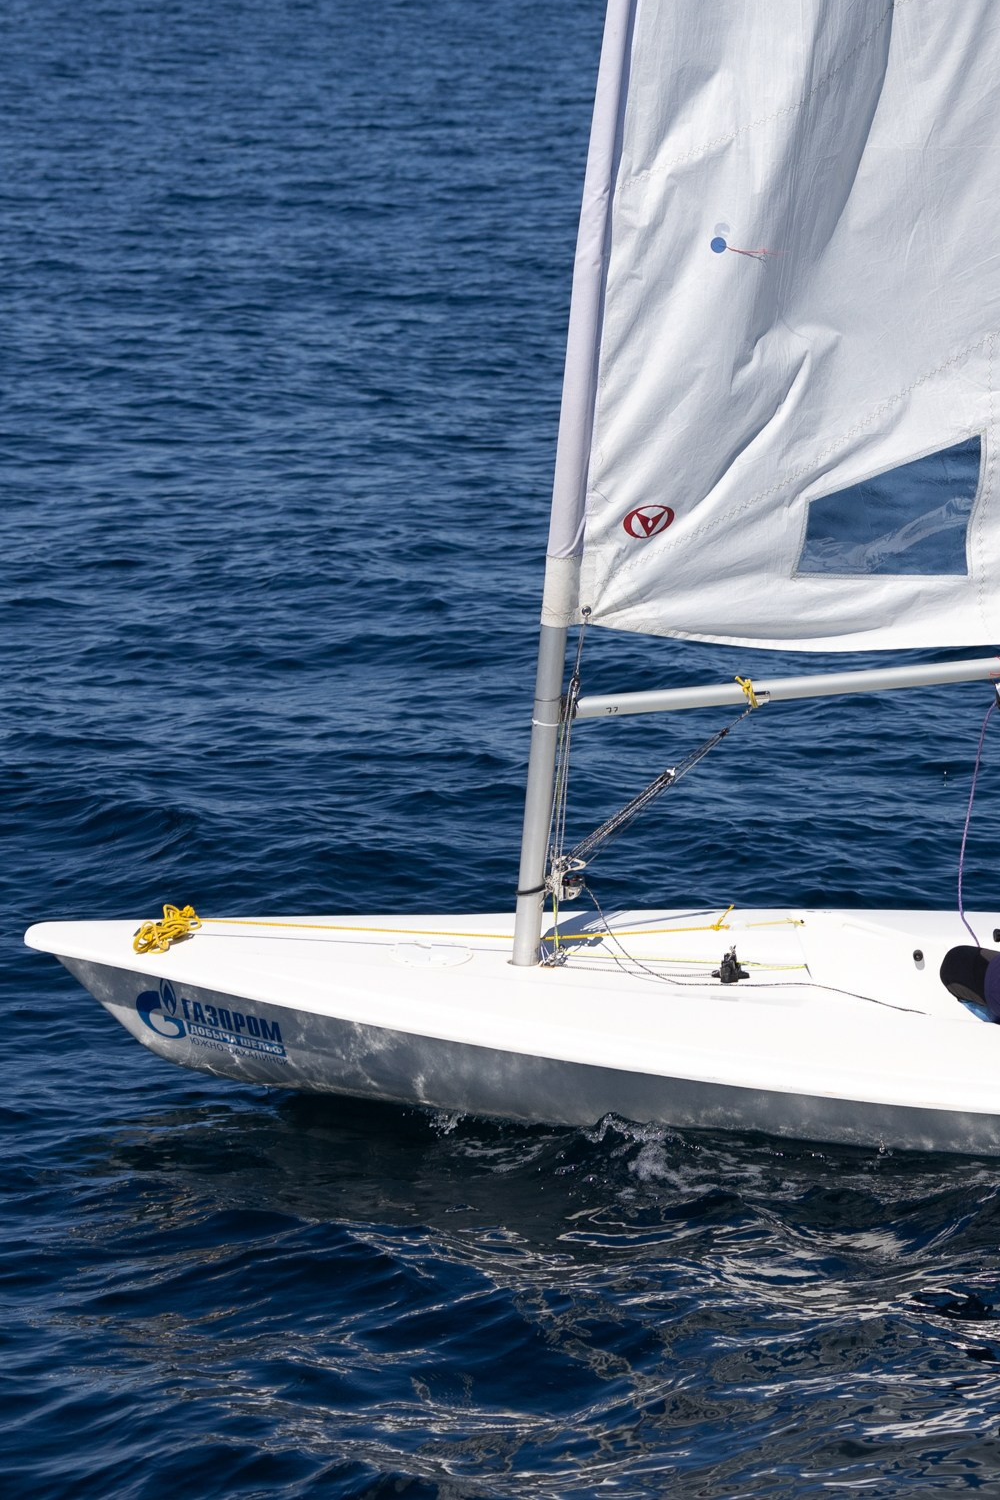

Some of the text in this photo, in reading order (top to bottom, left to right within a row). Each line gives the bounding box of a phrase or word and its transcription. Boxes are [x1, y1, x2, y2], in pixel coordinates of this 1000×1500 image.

[180, 998, 283, 1043] ГАЗПРОМ
[190, 1024, 283, 1055] ДОБЫЧА ШЕЛЬФ
